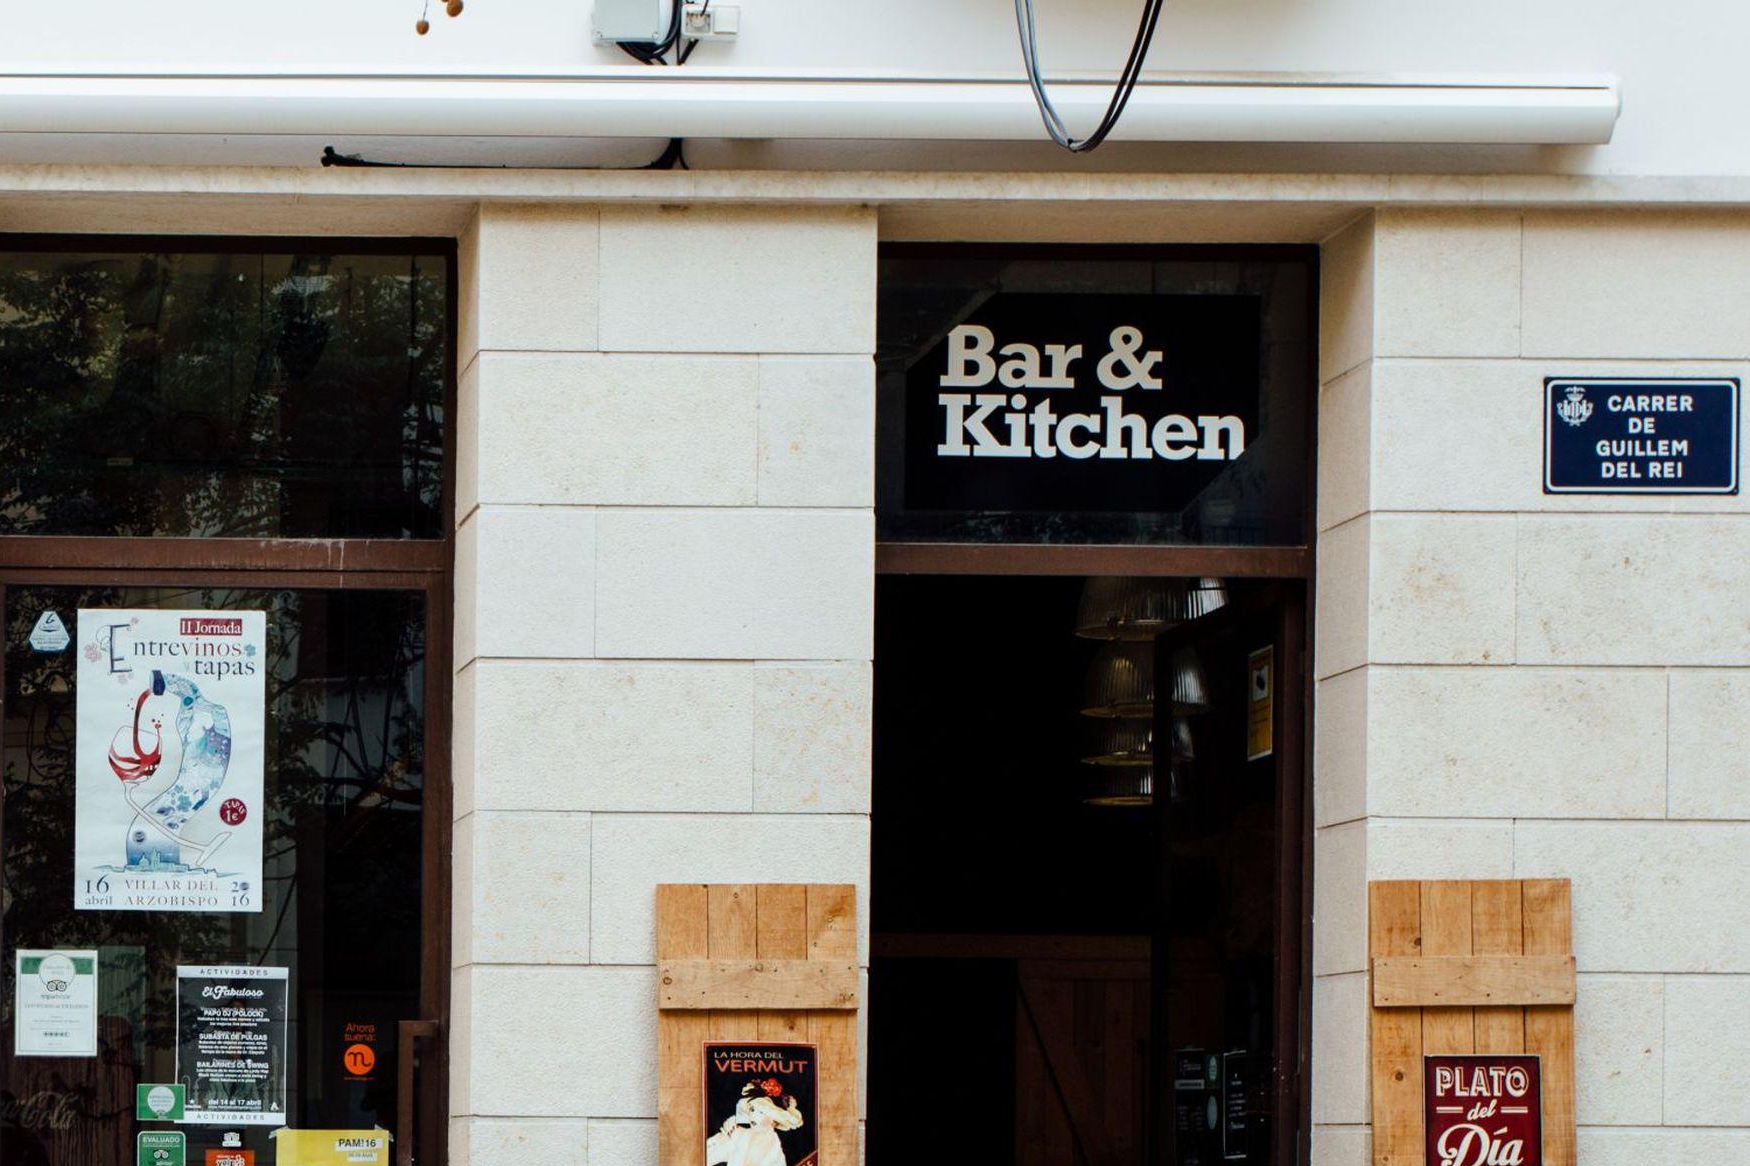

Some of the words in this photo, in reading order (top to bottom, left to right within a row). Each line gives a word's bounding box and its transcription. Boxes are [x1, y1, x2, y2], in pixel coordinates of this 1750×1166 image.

[940, 325, 1082, 388] Bar
[1096, 326, 1163, 390] &
[1607, 395, 1693, 412] CARRER
[938, 393, 1245, 460] Kitchen
[1628, 417, 1655, 434] DE
[1595, 440, 1688, 456] GUILLEM
[1601, 462, 1641, 478] DEL
[1649, 462, 1683, 478] REI
[194, 620, 241, 634] Jornada
[194, 660, 255, 680] tapas
[224, 800, 246, 815] TAPAS
[85, 873, 110, 894] 16
[124, 879, 181, 890] VILLAR
[187, 880, 218, 890] DEL
[85, 895, 113, 905] abril
[124, 895, 218, 906] ARZOBISPO
[231, 893, 250, 906] 16
[200, 968, 269, 976] ACTIVIDADES
[201, 986, 212, 997] El
[212, 985, 264, 999] Fabuloso
[198, 1033, 230, 1041] SUBASTA
[714, 1060, 809, 1074] VERMUT
[1436, 1066, 1529, 1097] PLATO
[1466, 1099, 1497, 1121] del
